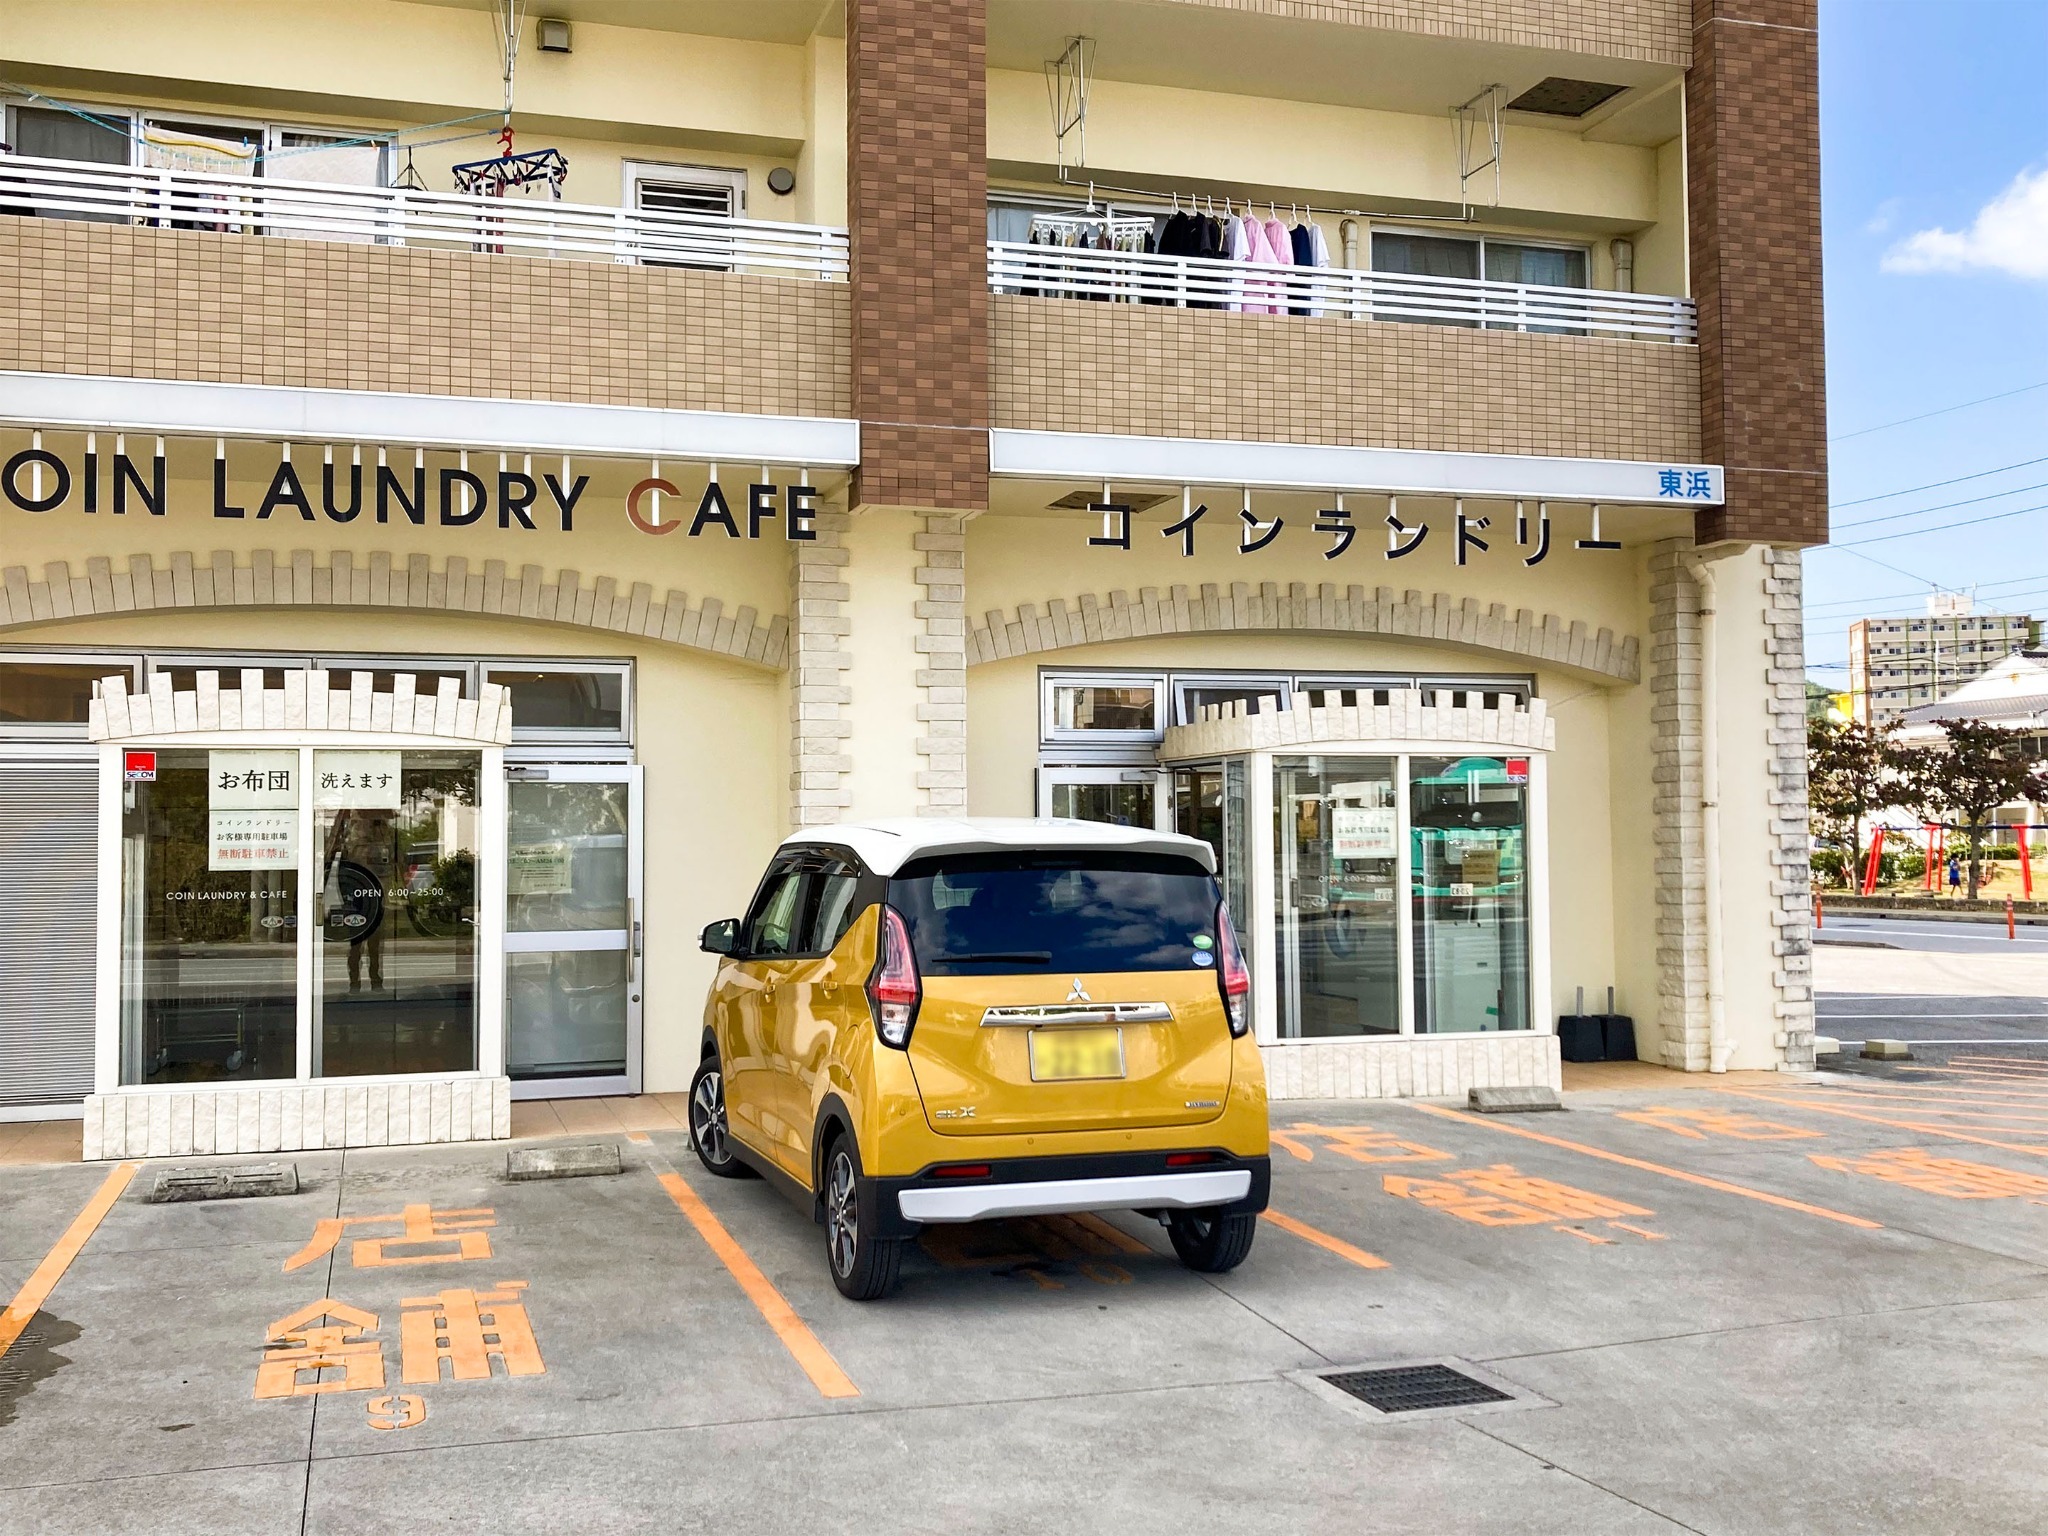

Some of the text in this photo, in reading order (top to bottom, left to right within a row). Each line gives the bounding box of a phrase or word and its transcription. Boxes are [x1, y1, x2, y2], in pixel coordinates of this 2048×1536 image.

[1657, 469, 1713, 500] 東浜
[1, 449, 819, 542] OIN LAUNDRY CAFE
[1085, 502, 1622, 567] コインランドリー
[218, 769, 290, 792] お布団
[321, 772, 393, 790] 洗えます
[216, 819, 291, 827] コインランドリー
[216, 832, 288, 842] お客様専用駐車場
[217, 848, 289, 860] 無断駐車禁止
[166, 890, 288, 901] COIN LAUNDRY & CAFE
[354, 888, 382, 898] OPEN
[366, 1394, 426, 1430] 9
